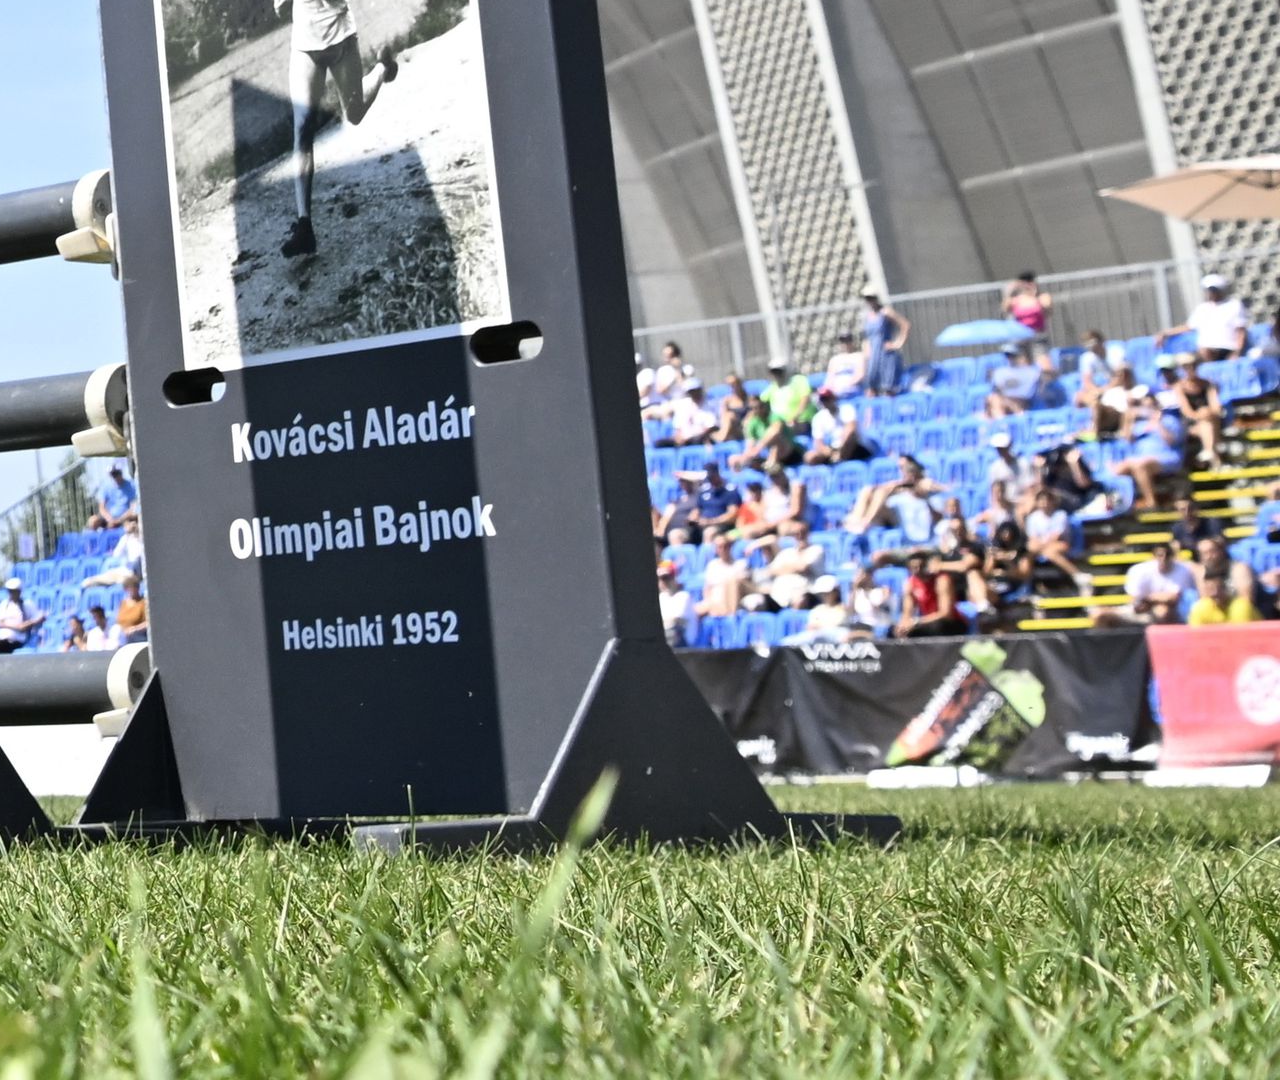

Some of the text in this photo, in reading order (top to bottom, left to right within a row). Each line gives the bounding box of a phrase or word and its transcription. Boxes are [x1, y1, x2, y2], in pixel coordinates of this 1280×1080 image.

[231, 394, 476, 463] Kovácsi Aladár
[229, 495, 497, 562] Olimpiai Bajnok
[282, 610, 460, 651] Helsinki 1952
